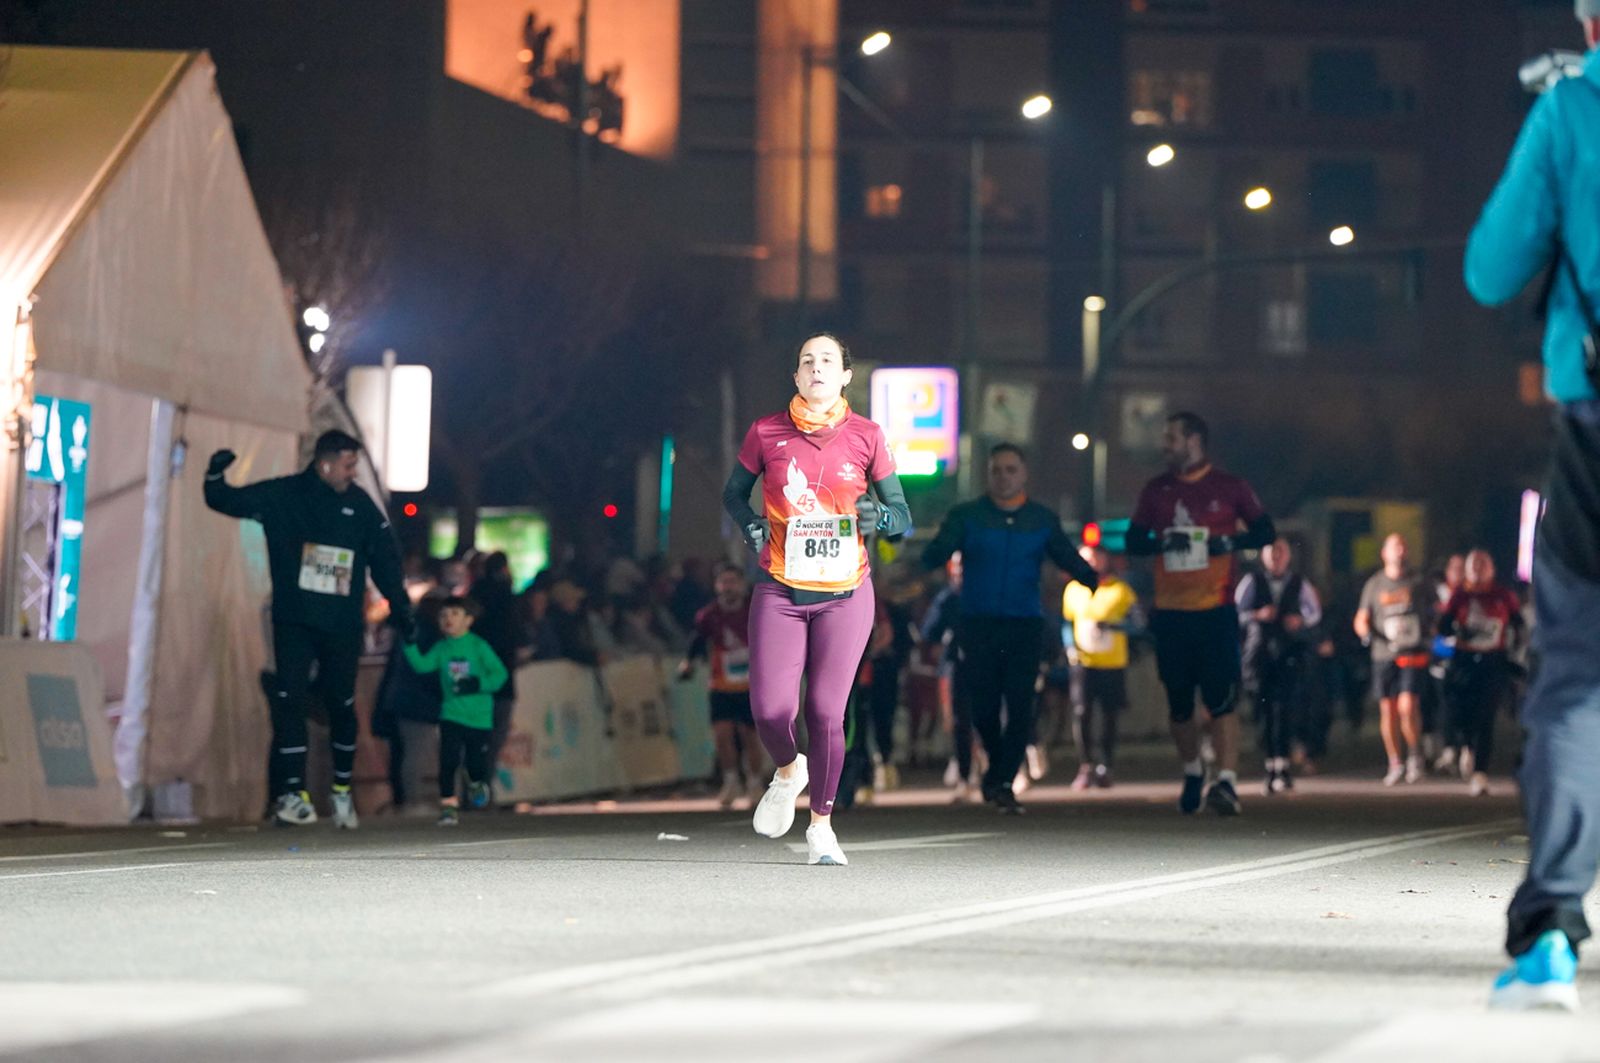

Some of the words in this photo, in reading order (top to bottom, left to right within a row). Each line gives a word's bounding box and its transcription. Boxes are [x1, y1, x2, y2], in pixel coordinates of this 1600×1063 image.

[796, 493, 816, 513] 43
[802, 521, 823, 529] NOCHE
[804, 538, 840, 558] 849
